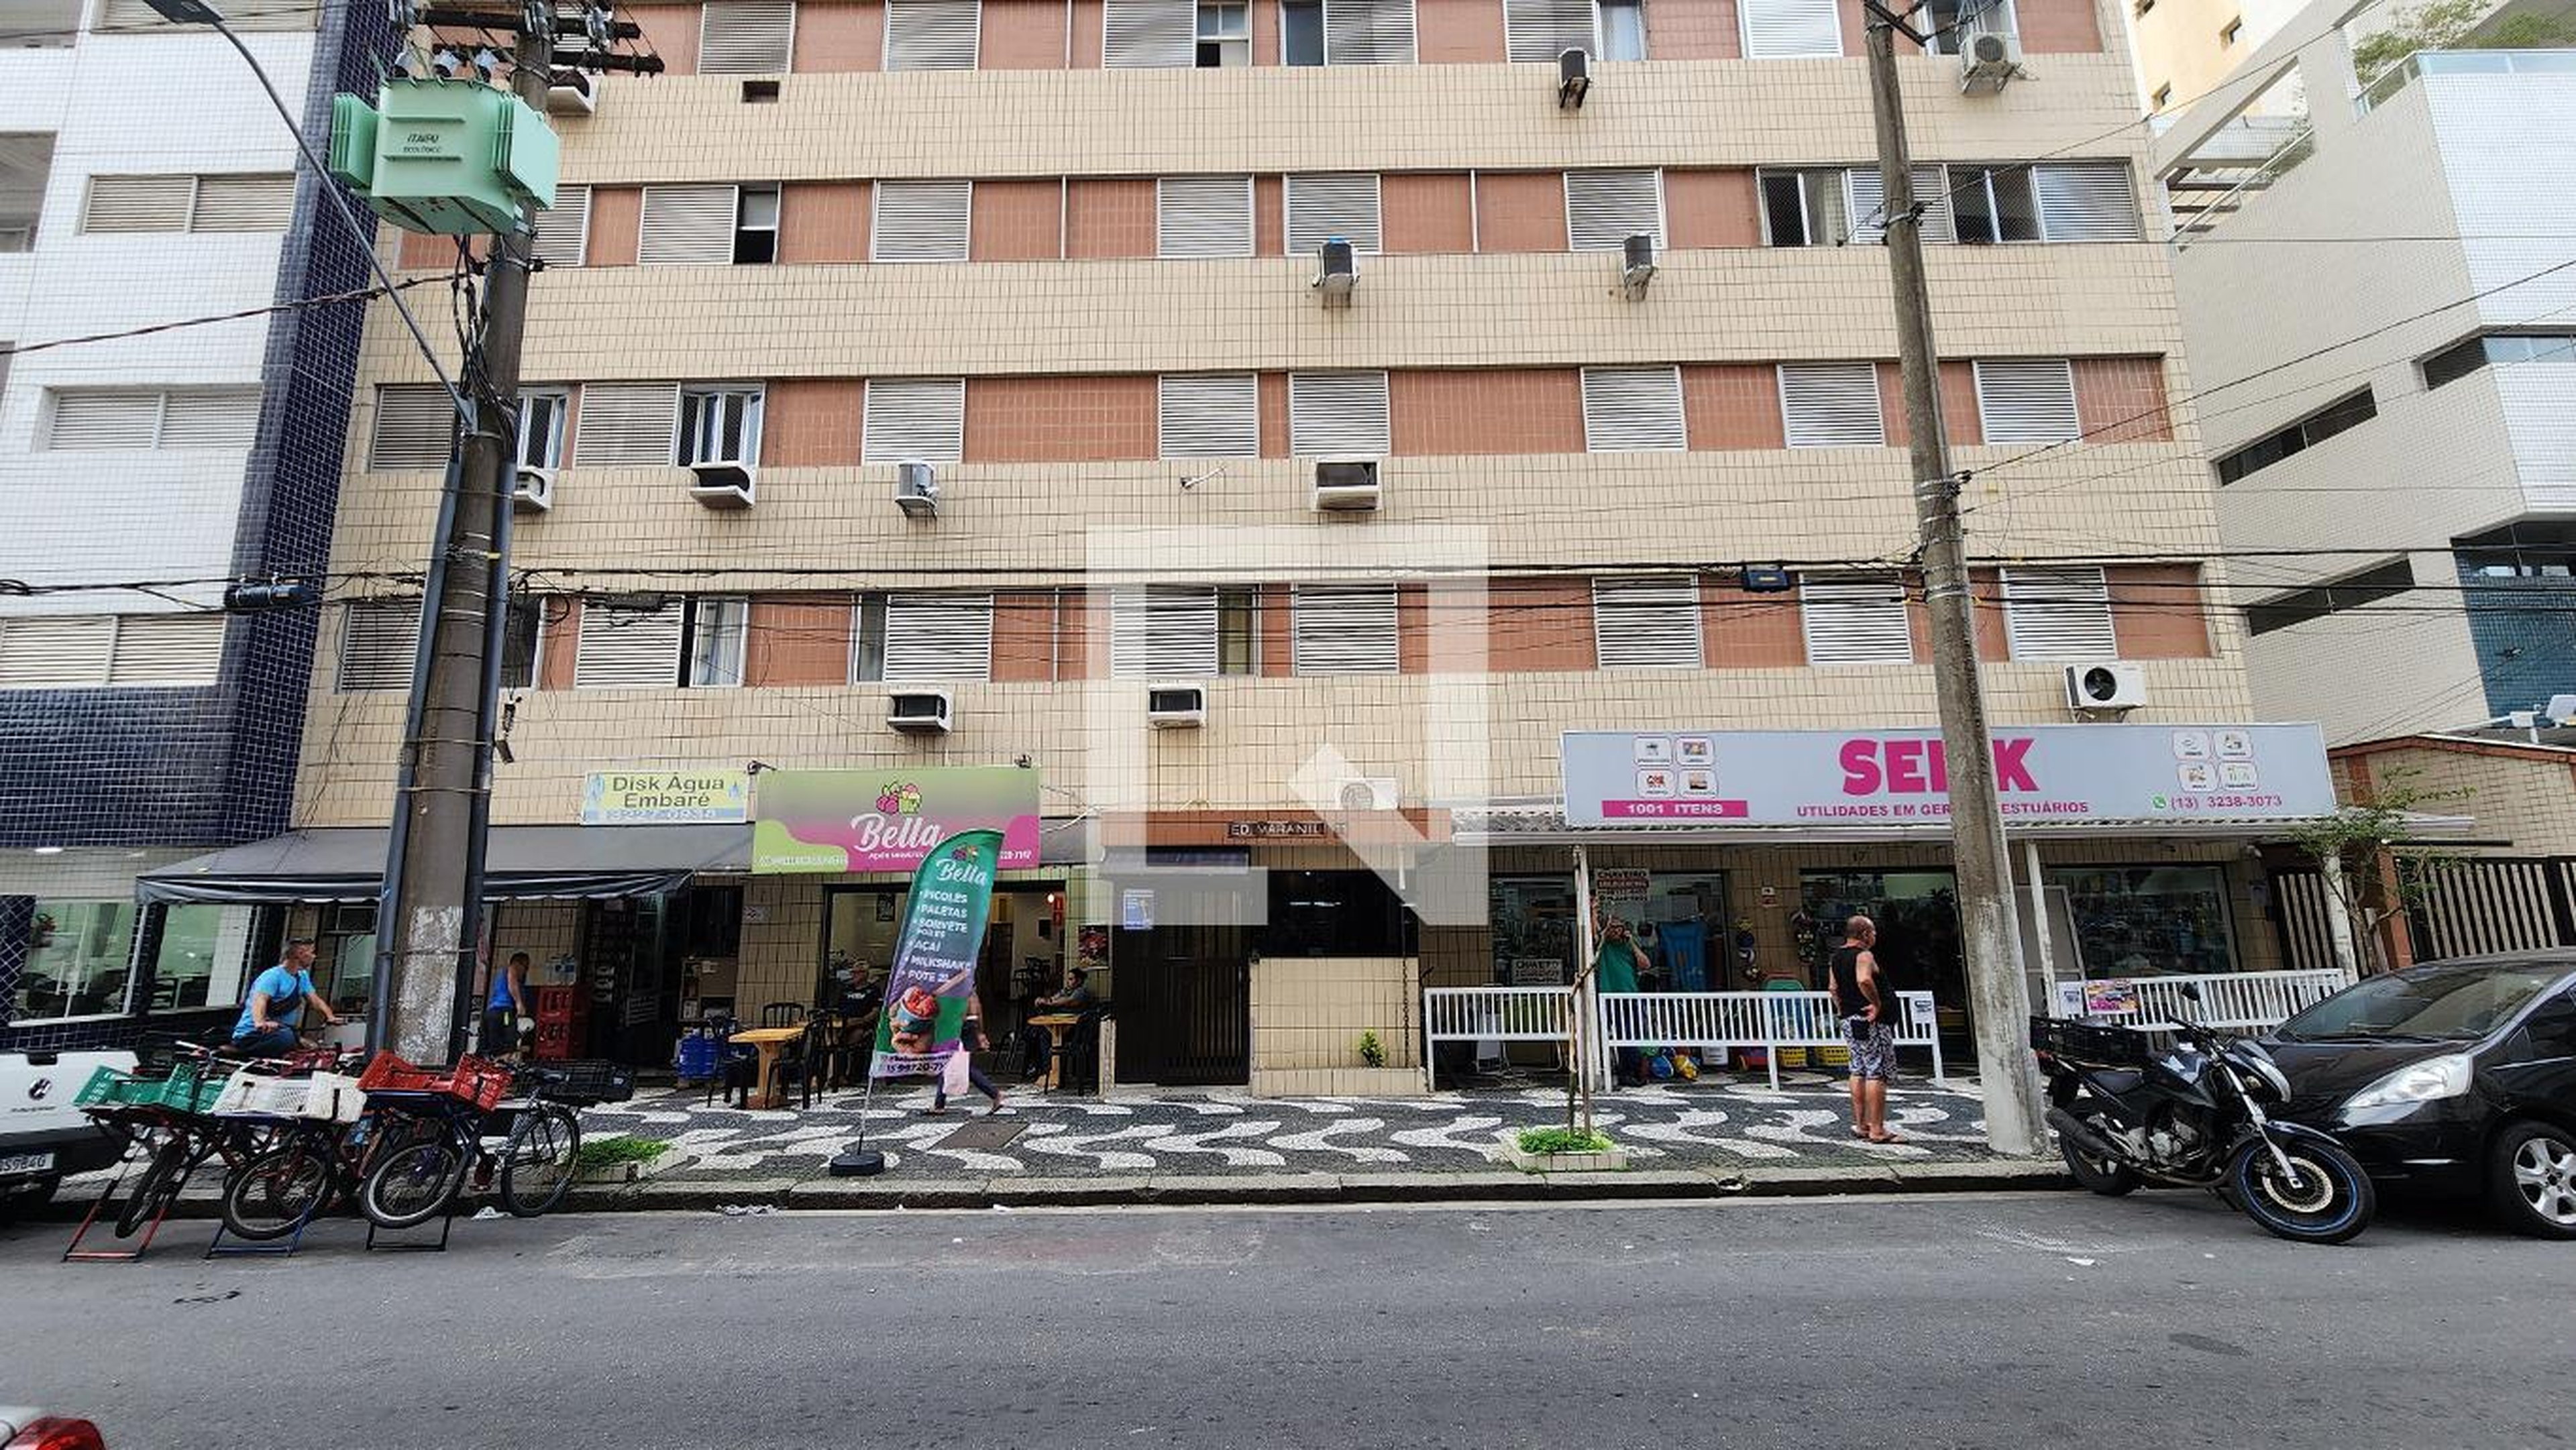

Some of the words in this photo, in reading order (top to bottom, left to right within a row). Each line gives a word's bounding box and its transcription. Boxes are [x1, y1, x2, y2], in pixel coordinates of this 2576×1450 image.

[612, 776, 660, 792] Disk
[666, 771, 724, 794] Água
[625, 792, 710, 807] Embaré
[2171, 797, 2199, 810] (13)
[2207, 795, 2282, 808] 3238-3073
[1628, 804, 1664, 814] 1001
[1675, 804, 1723, 814] ITENS
[1797, 805, 1888, 817] UTILIDADES
[1893, 805, 1916, 816] EM
[1921, 803, 1951, 815] GER
[2001, 800, 2088, 814] ESTUÁRIOS
[850, 813, 943, 852] Bella
[936, 858, 987, 886] Bella
[921, 904, 967, 918] PALETAS
[919, 917, 967, 934] SORVETE
[908, 970, 936, 983] POTE
